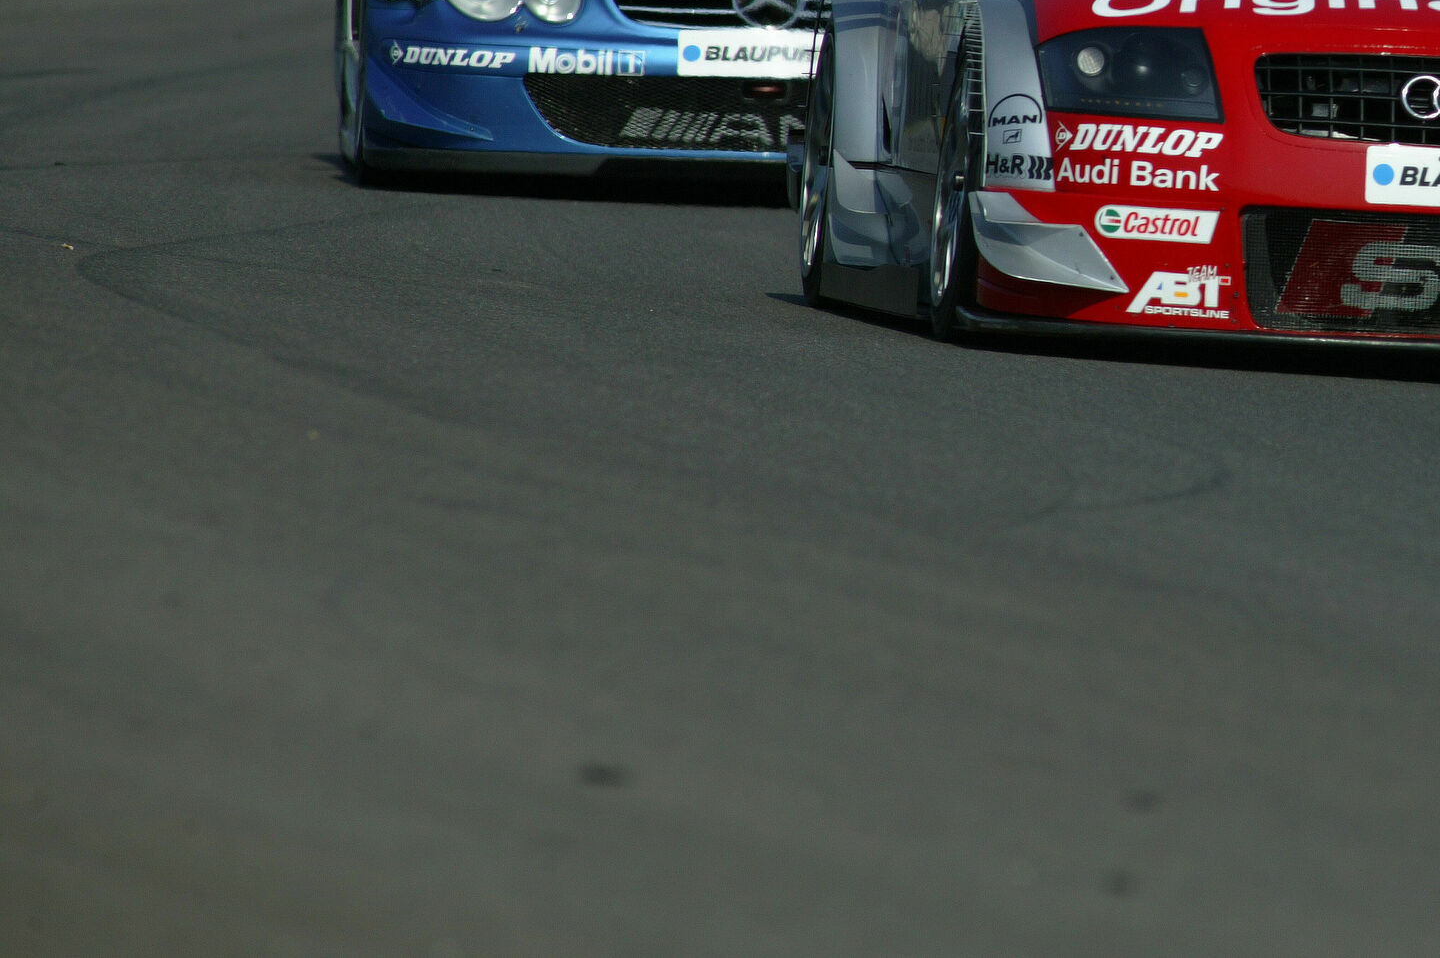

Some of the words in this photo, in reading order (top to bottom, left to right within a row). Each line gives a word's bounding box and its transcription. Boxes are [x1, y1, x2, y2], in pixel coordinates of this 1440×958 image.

[403, 46, 516, 69] DUNLOP
[528, 47, 613, 75] Mobil
[992, 115, 1038, 126] MAN
[1069, 123, 1225, 158] DUNLOP
[985, 153, 1026, 175] H&R
[1056, 157, 1120, 185] Audi
[1129, 160, 1220, 192] Bank
[1123, 211, 1200, 237] Castrol
[1187, 265, 1218, 281] TEAM
[1125, 271, 1220, 313] ABT
[1144, 305, 1230, 319] SPORTSLINE
